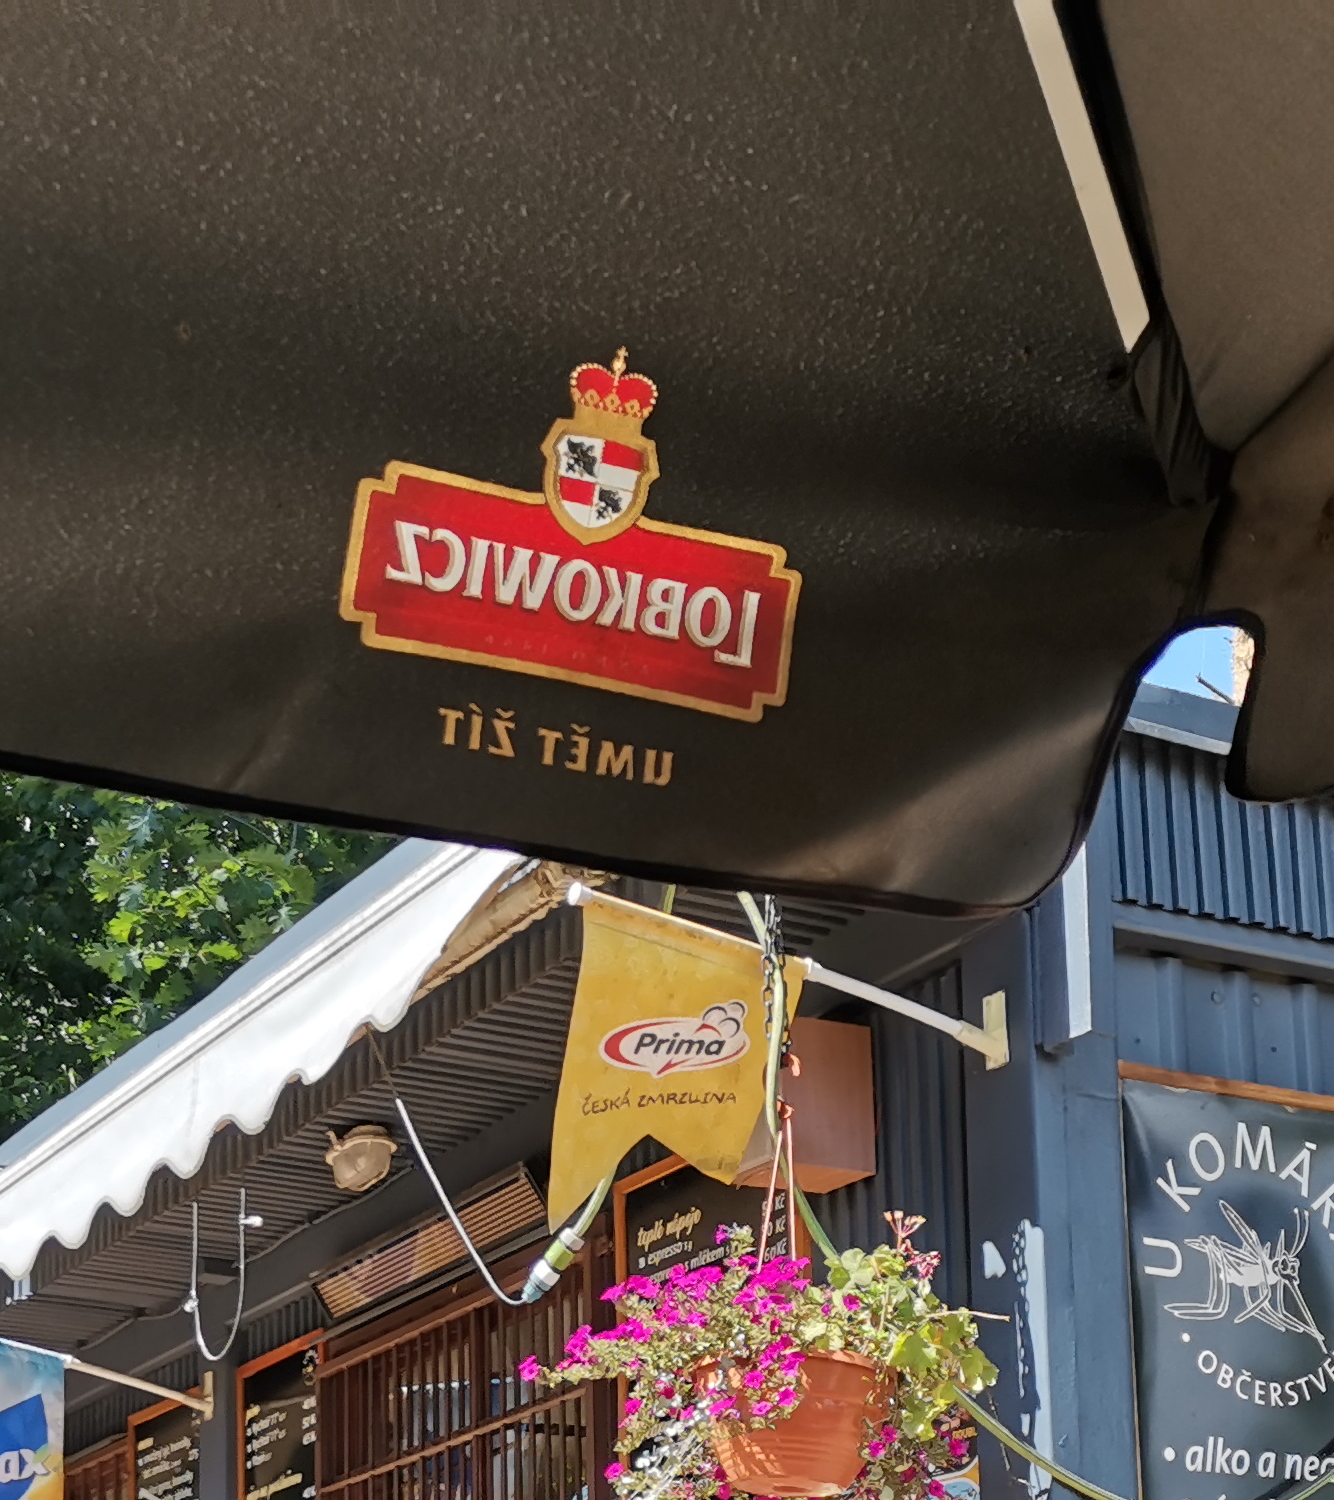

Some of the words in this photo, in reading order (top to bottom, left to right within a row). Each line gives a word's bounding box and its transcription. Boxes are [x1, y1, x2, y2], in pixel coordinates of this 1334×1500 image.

[633, 1032, 726, 1057] Prima
[581, 1087, 631, 1116] ČESKÁ
[637, 1092, 737, 1108] ZMRZLINA
[1142, 1236, 1183, 1278] U
[1185, 1436, 1250, 1475] alko
[1258, 1455, 1275, 1478] a
